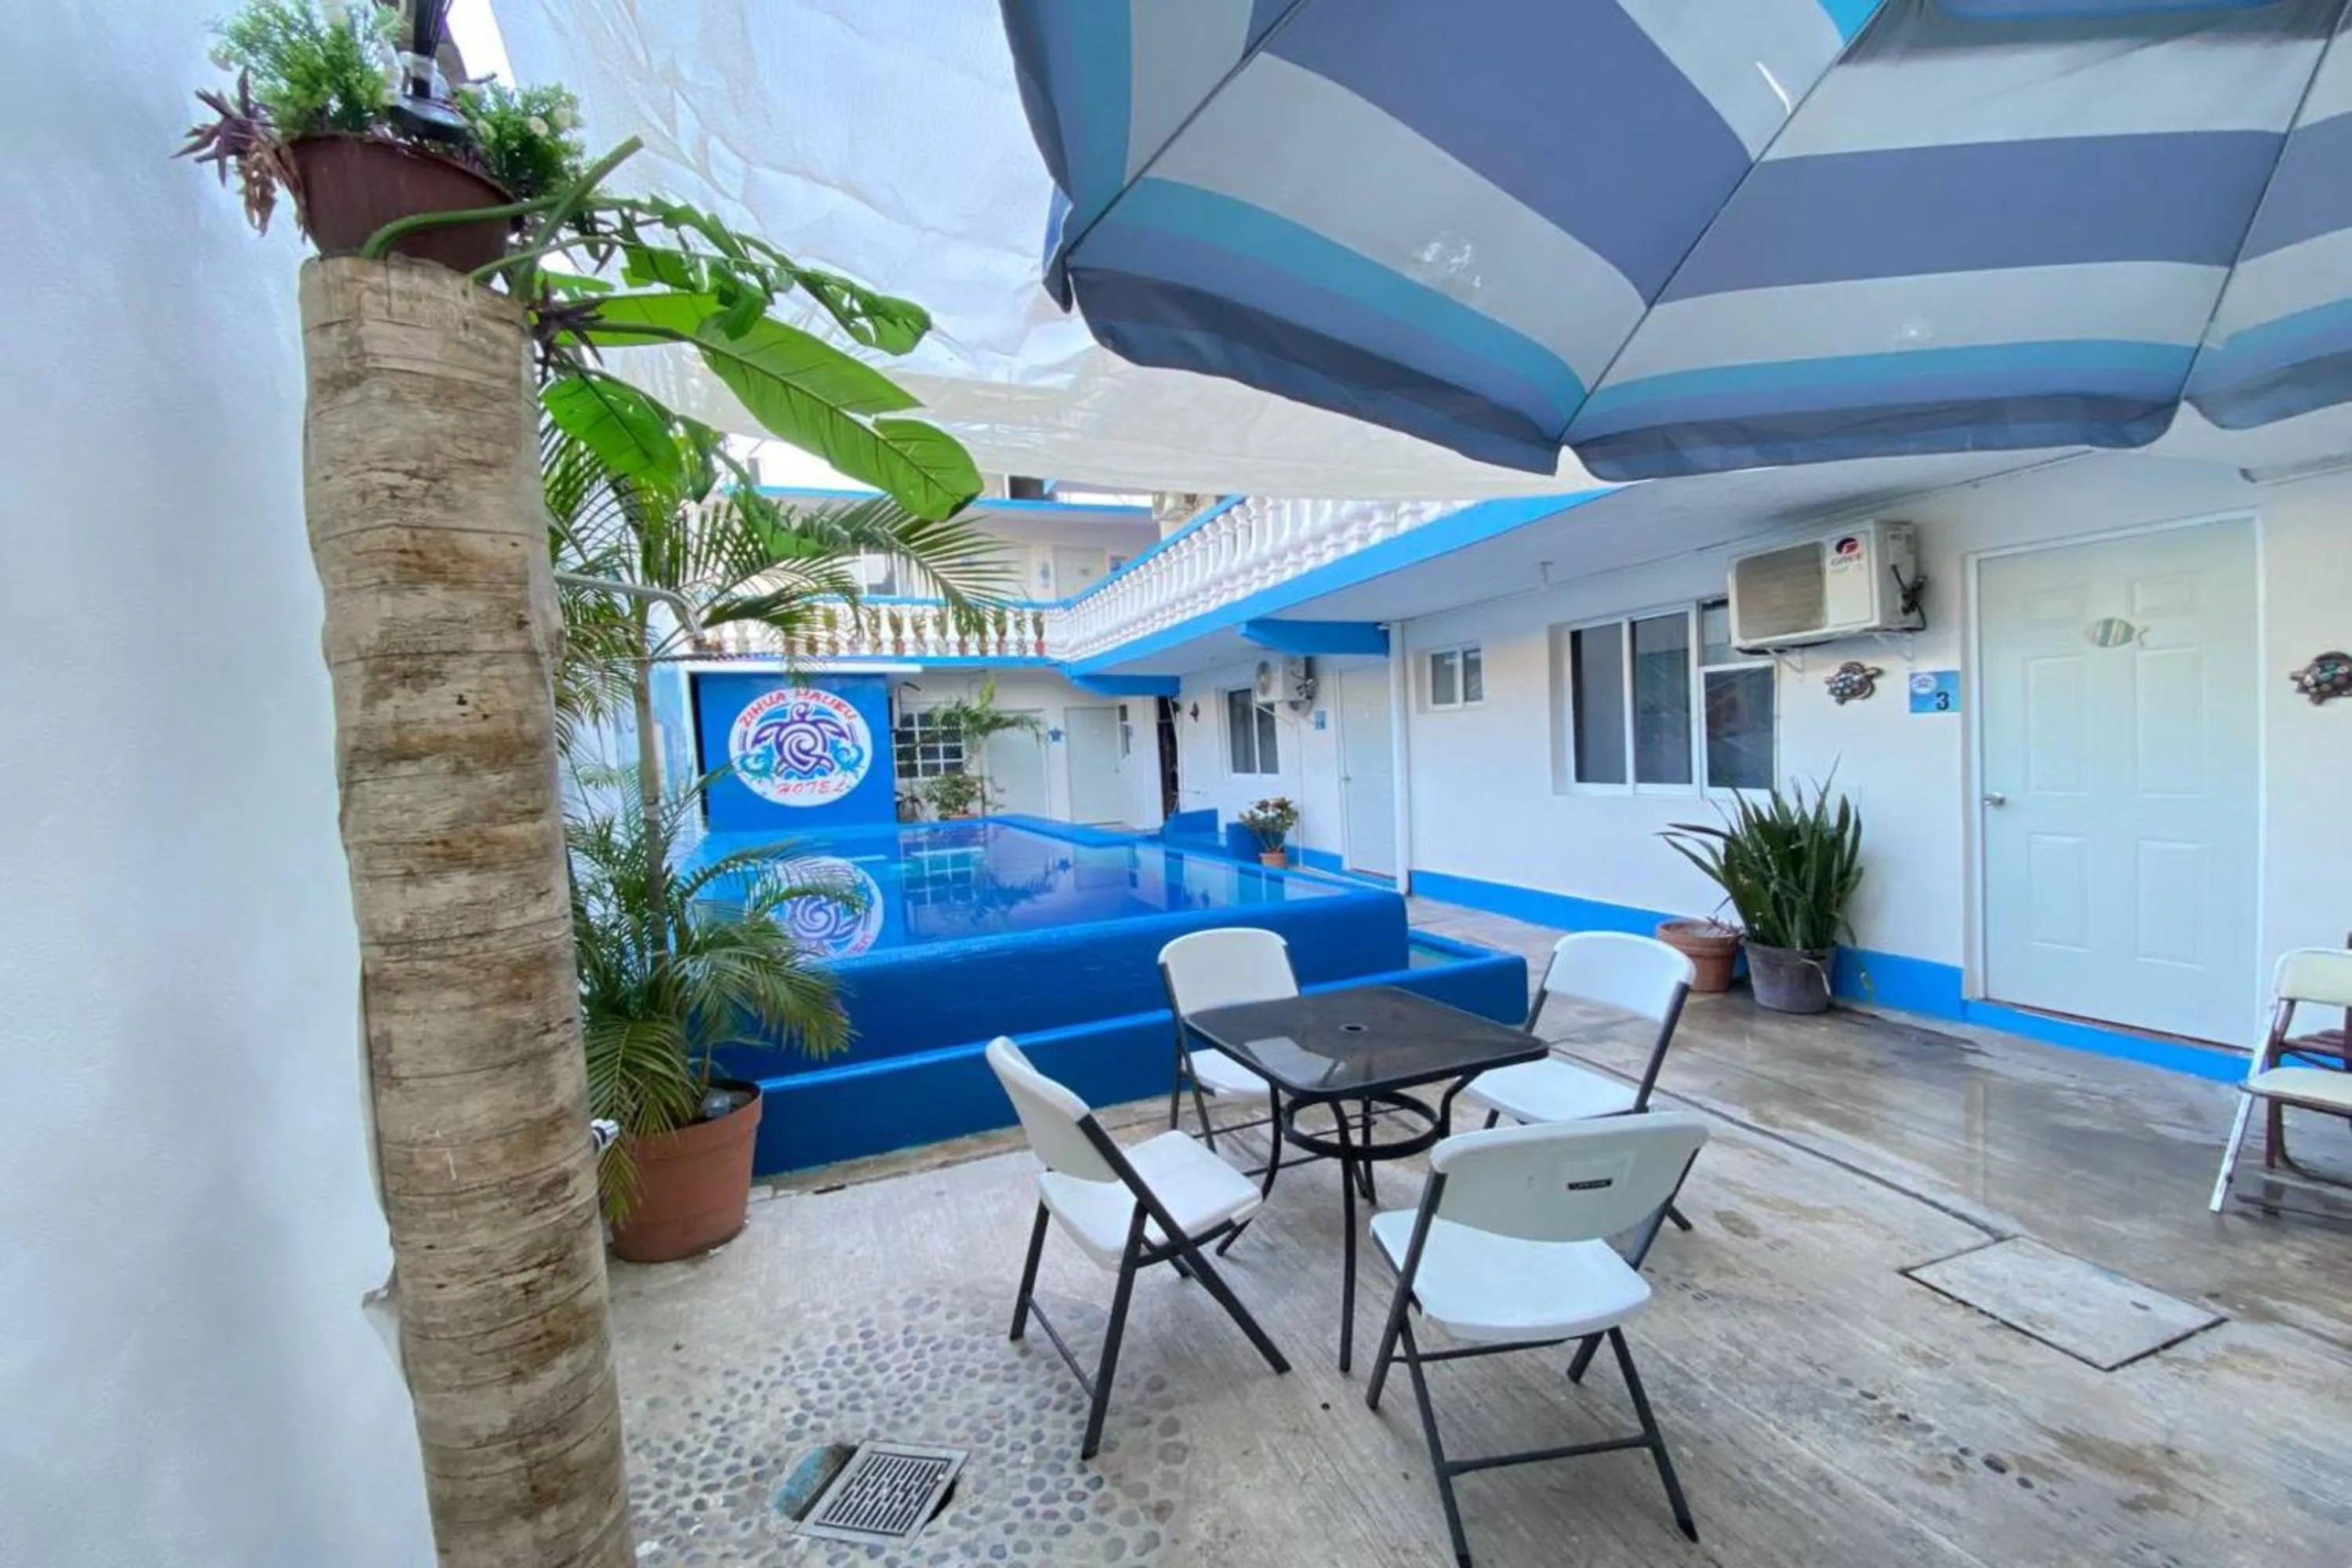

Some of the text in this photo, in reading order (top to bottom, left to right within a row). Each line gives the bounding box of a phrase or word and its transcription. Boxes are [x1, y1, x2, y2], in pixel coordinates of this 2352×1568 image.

[739, 691, 786, 728] ZIHUA
[1936, 691, 1949, 710] 3
[776, 779, 847, 795] HOTEL
